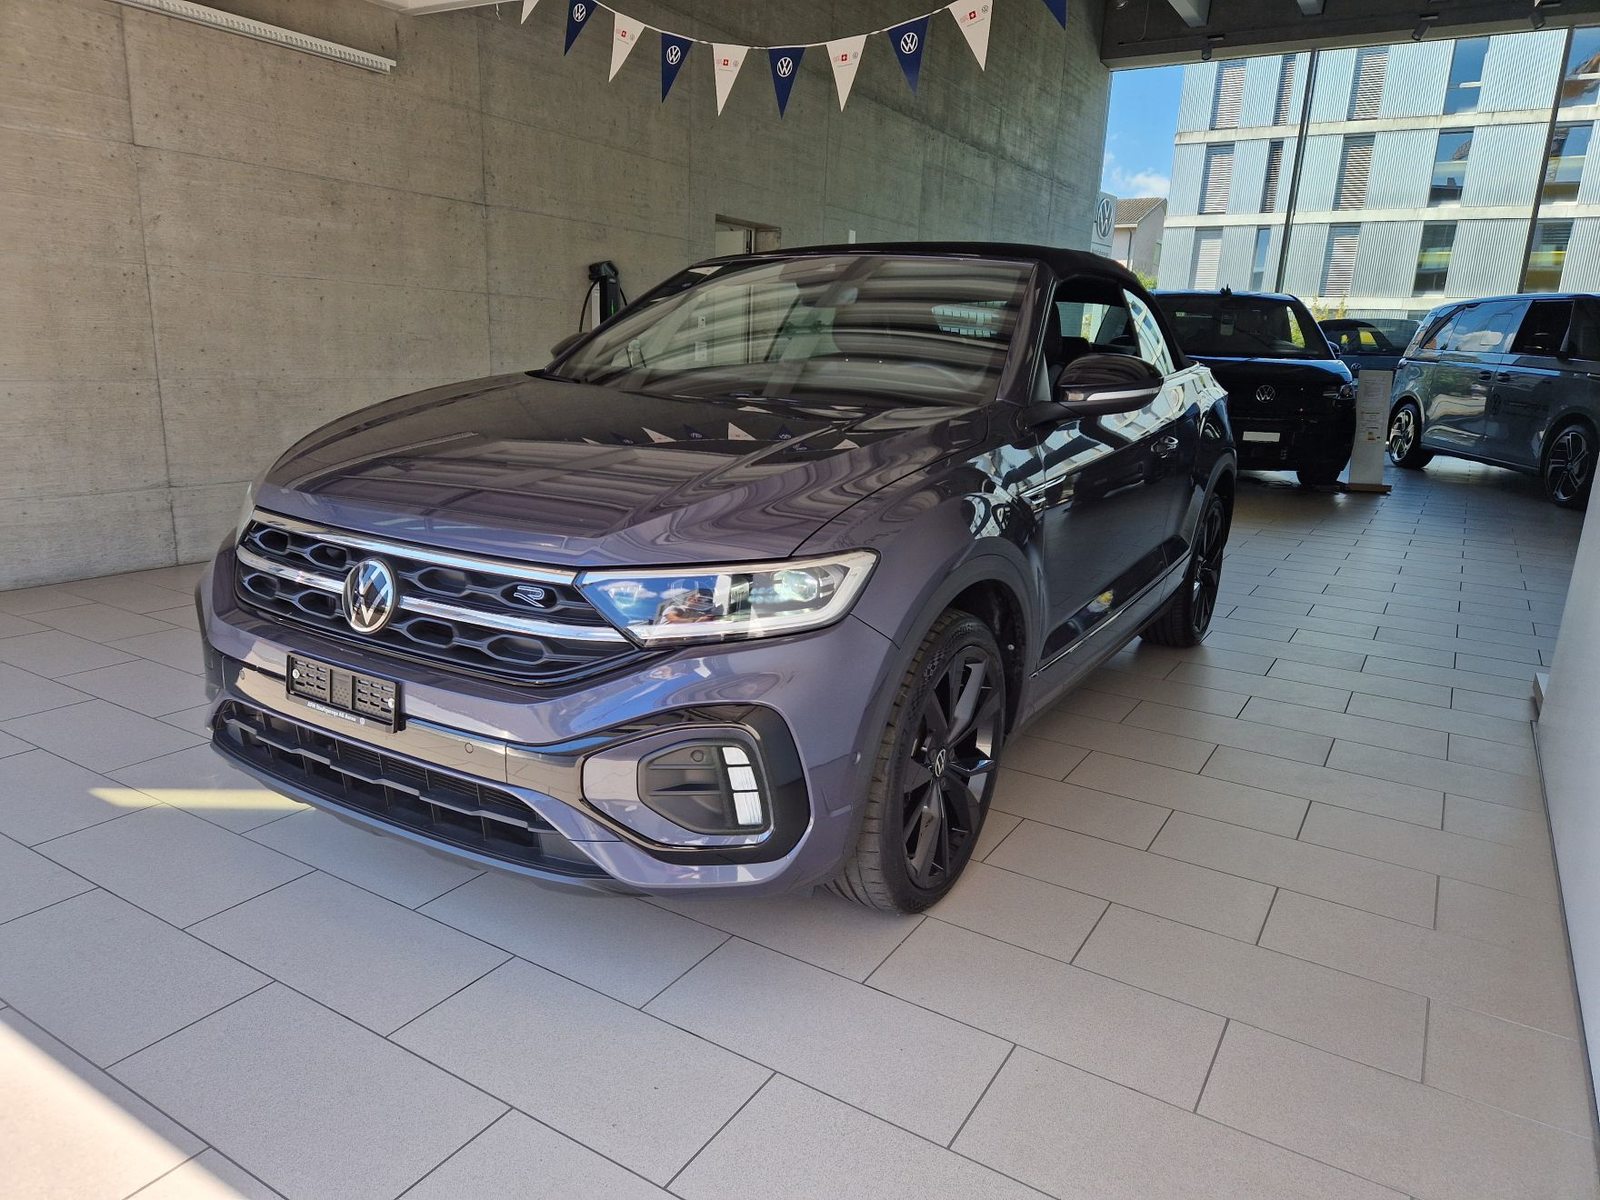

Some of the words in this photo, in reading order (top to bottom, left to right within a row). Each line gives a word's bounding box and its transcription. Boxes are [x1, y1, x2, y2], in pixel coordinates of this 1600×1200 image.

[573, 3, 587, 22] VW
[901, 32, 918, 54] VW
[666, 45, 681, 65] VW
[777, 57, 793, 77] VW
[1097, 198, 1114, 239] VW
[1256, 385, 1275, 402] VW
[343, 560, 393, 633] VW
[514, 585, 545, 608] R
